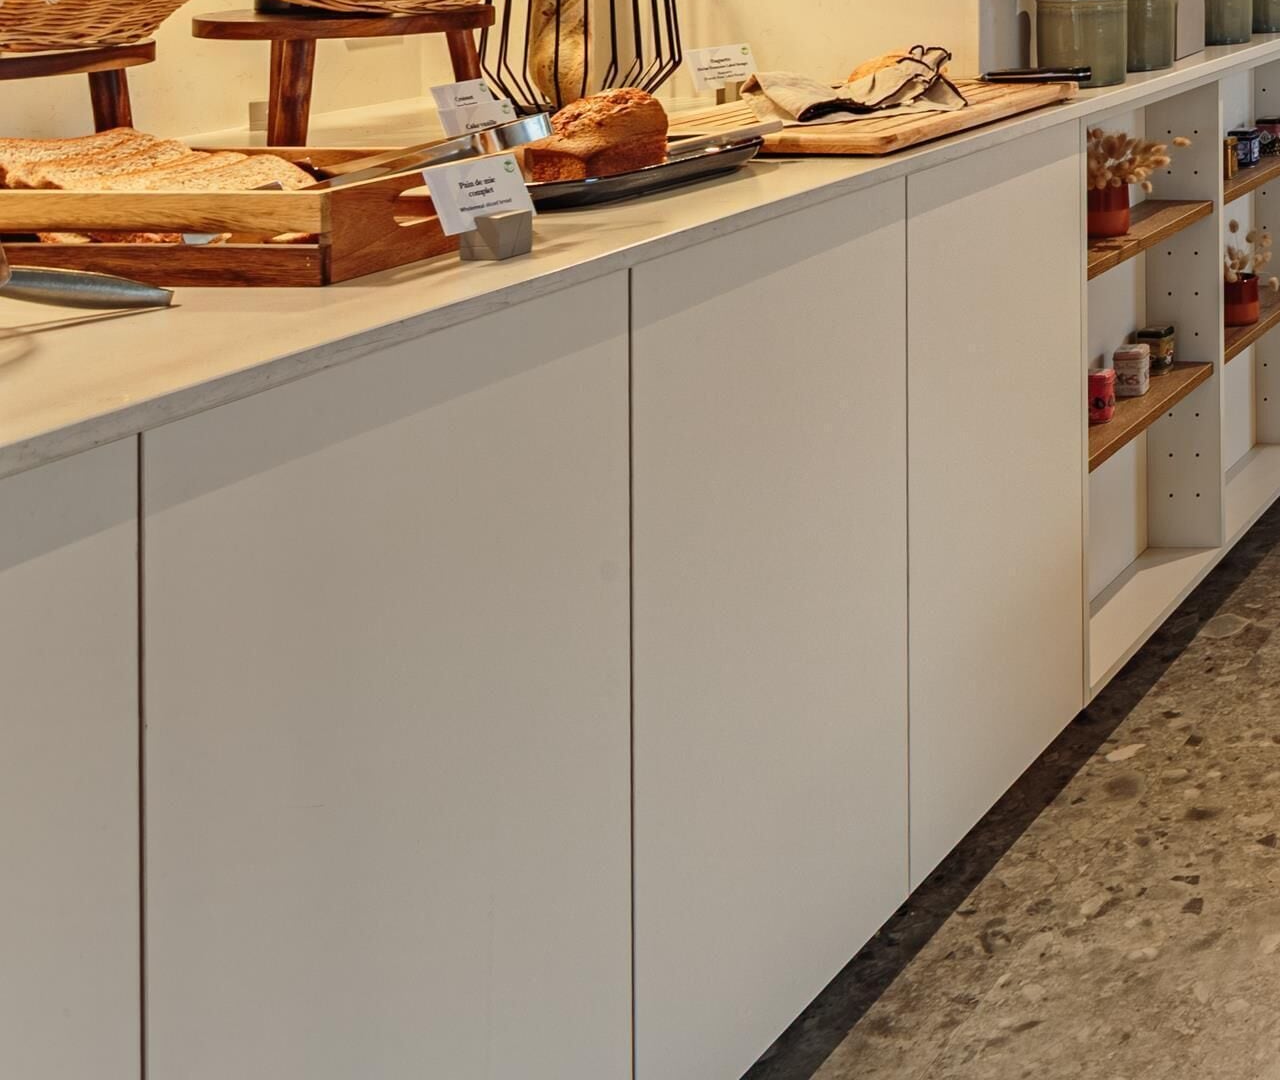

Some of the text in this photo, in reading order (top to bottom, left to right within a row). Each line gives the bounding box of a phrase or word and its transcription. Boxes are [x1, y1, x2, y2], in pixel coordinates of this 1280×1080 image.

[458, 180, 474, 189] Pain
[475, 178, 483, 186] de
[468, 186, 495, 198] complet
